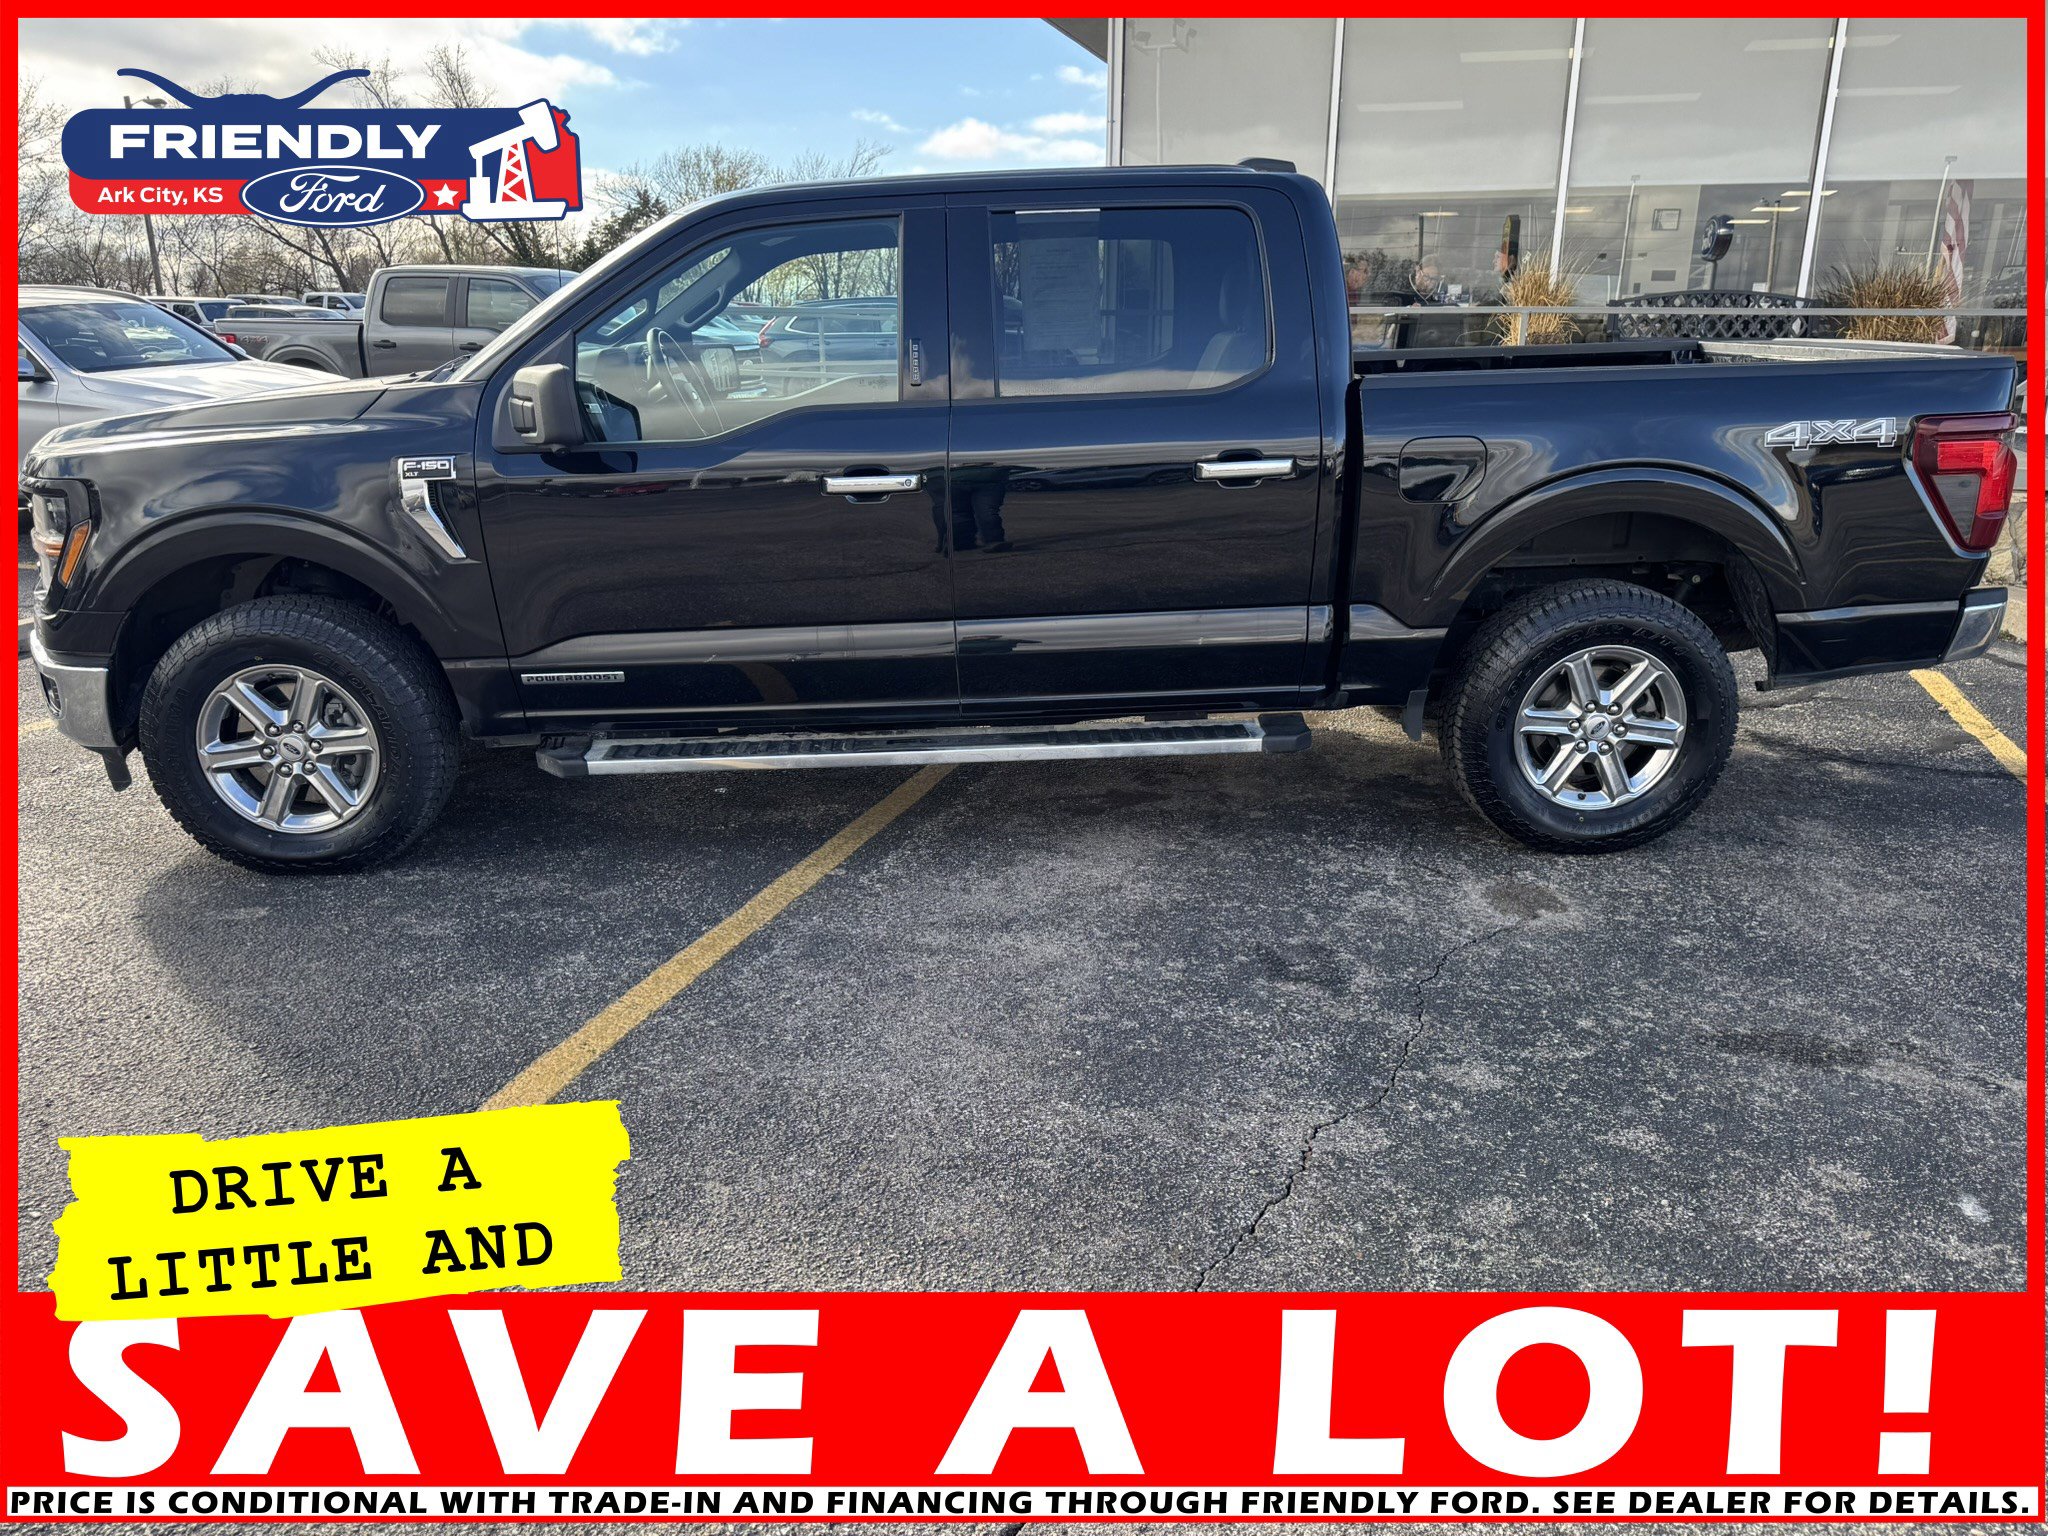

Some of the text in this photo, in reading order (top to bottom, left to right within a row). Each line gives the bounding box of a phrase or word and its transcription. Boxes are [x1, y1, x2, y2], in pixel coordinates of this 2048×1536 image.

[403, 460, 450, 472] F-150
[404, 470, 419, 478] XLT
[526, 673, 620, 683] POWERBOOST
